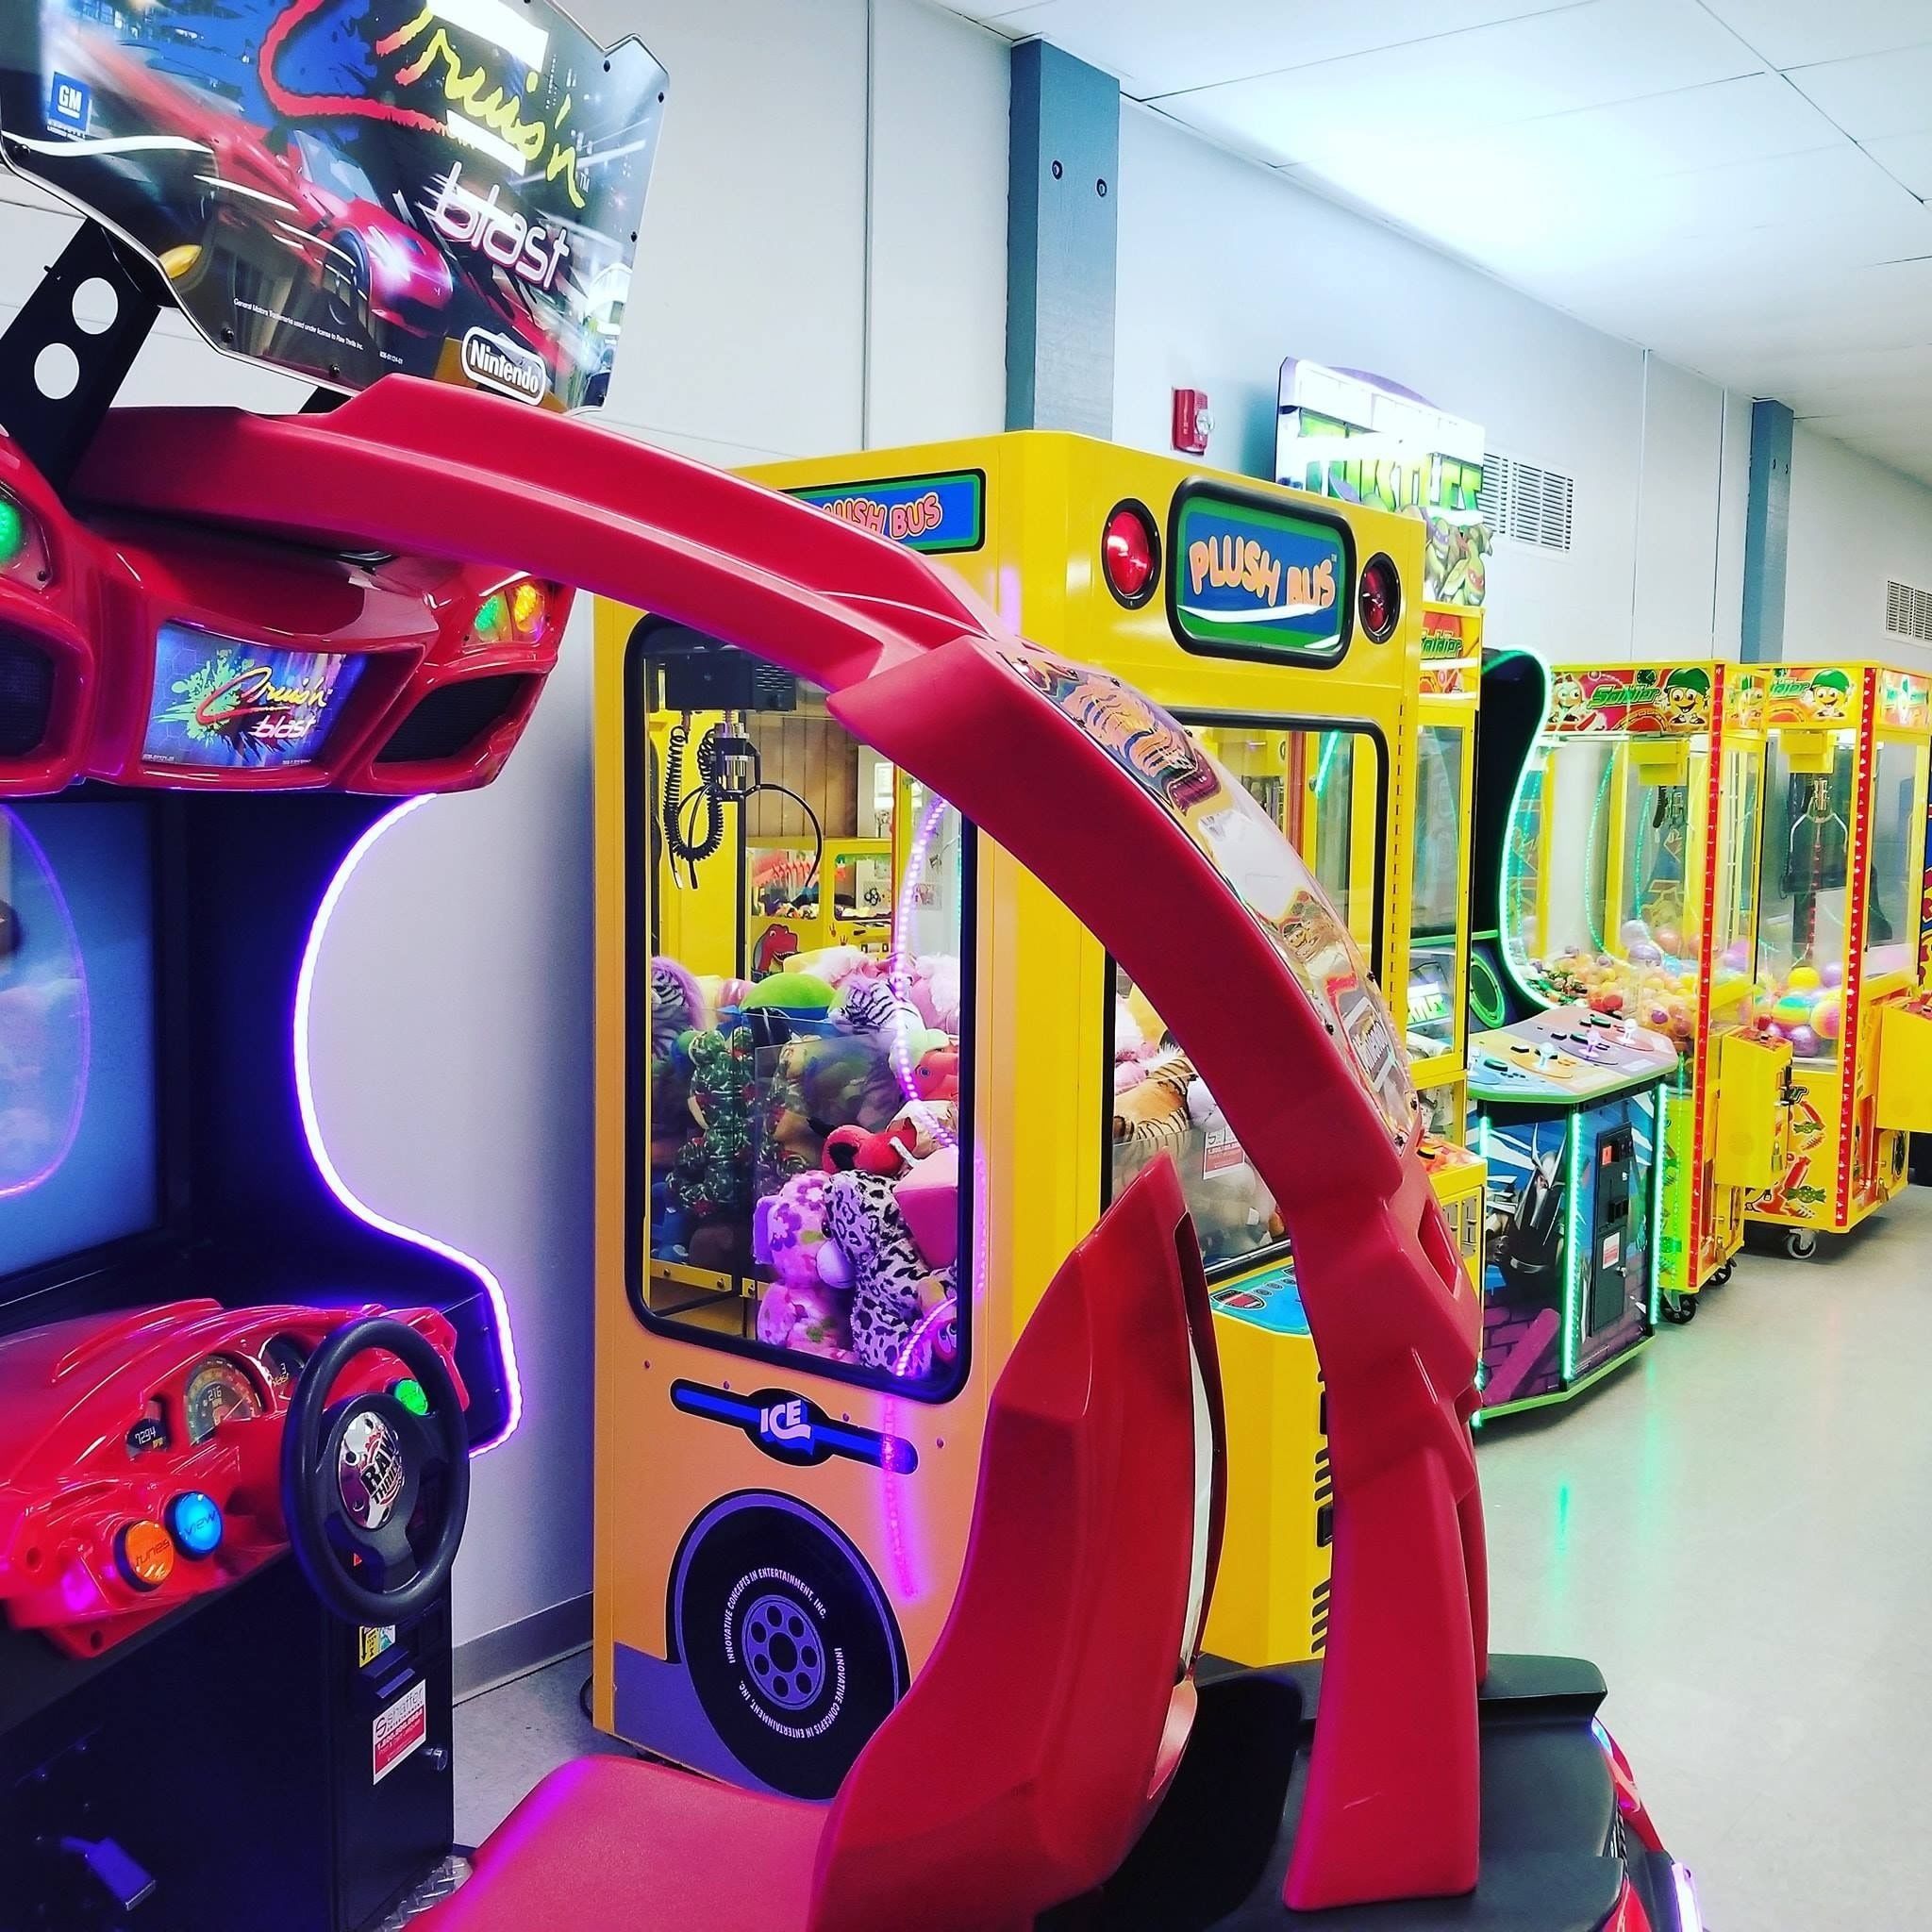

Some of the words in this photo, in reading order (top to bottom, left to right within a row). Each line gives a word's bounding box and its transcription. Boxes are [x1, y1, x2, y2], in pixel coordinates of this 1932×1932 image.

[58, 84, 82, 112] GM
[423, 161, 570, 289] blast
[471, 339, 540, 393] Nintendo
[890, 491, 943, 541] BUS
[1189, 535, 1281, 607] PLUSH
[1287, 558, 1336, 608] BUS
[1421, 629, 1464, 658] oldier
[196, 666, 326, 725] Cruis'n
[249, 714, 317, 739] blast
[760, 1400, 811, 1441] ICE
[136, 1539, 170, 1566] tunes
[726, 1574, 751, 1609] CONCEPTS
[749, 1570, 758, 1581] IN
[758, 1567, 814, 1602] ENTERTAINMENT,
[813, 1597, 828, 1620] INC.
[724, 1609, 737, 1664] INNOVATIVE
[739, 1680, 752, 1702] INC.
[833, 1647, 846, 1704] INNOVATIVE
[751, 1699, 806, 1739] ENTERTAINMENT,
[807, 1726, 815, 1738] IN
[815, 1701, 841, 1735] CONCEPTS
